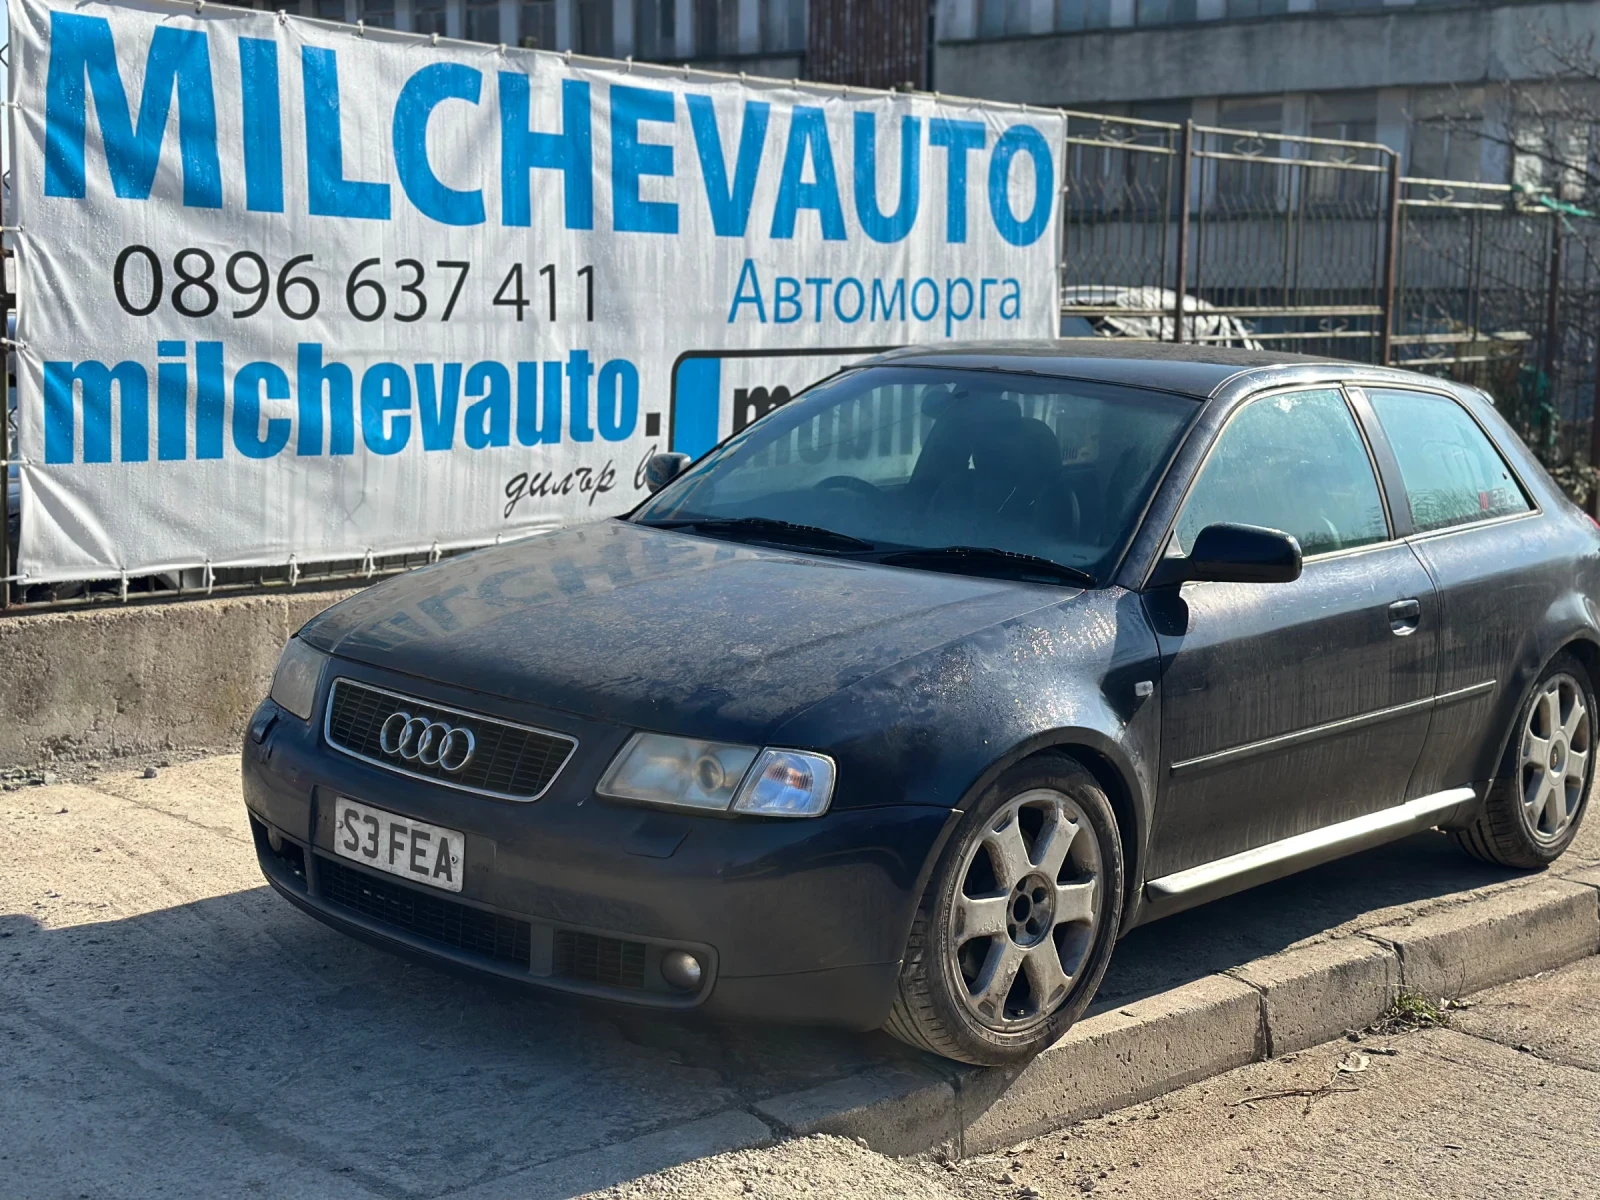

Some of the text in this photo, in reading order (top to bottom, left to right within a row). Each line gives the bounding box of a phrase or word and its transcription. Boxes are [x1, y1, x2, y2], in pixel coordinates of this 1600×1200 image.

[44, 11, 1054, 247] MILCHEVAUTO
[114, 245, 593, 322] 0896 637 411
[728, 258, 1021, 337] Автоморга
[504, 460, 616, 520] дилър
[343, 808, 452, 882] S3 FEA
